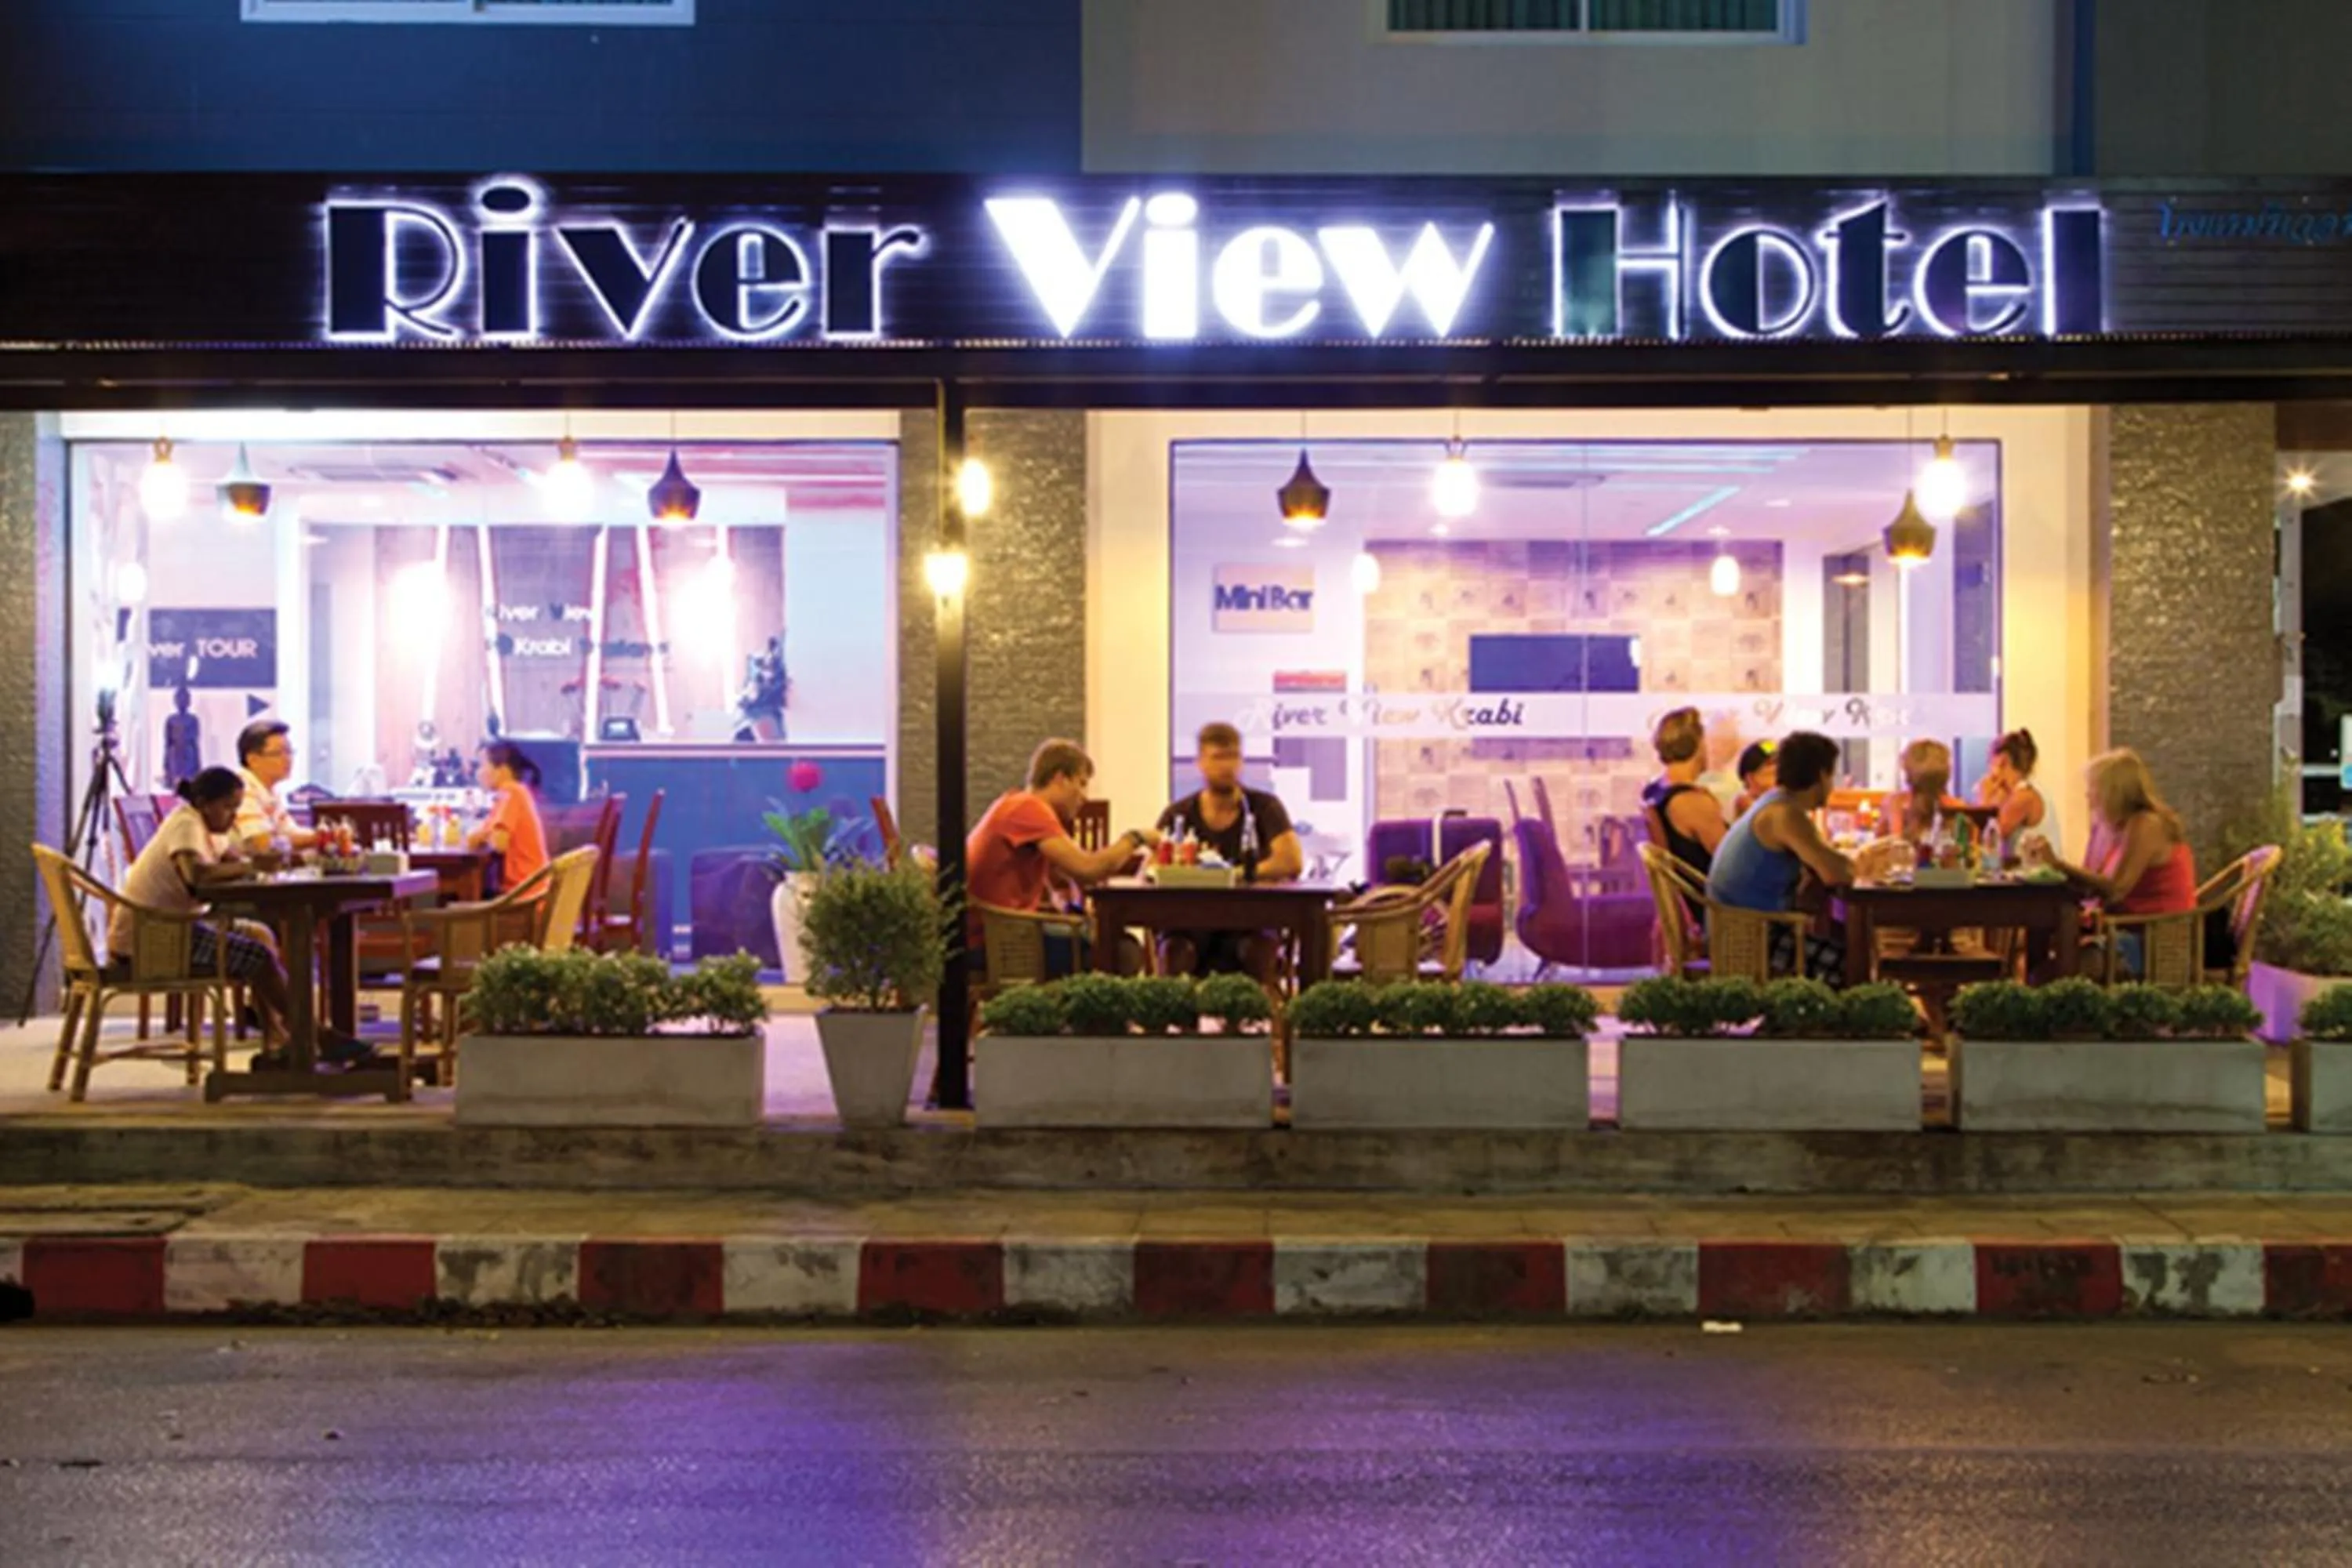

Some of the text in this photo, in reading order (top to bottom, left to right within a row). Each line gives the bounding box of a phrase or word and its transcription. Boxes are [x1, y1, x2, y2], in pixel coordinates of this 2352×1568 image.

[323, 180, 2107, 341] River View Hotel
[196, 637, 259, 659] TOUR
